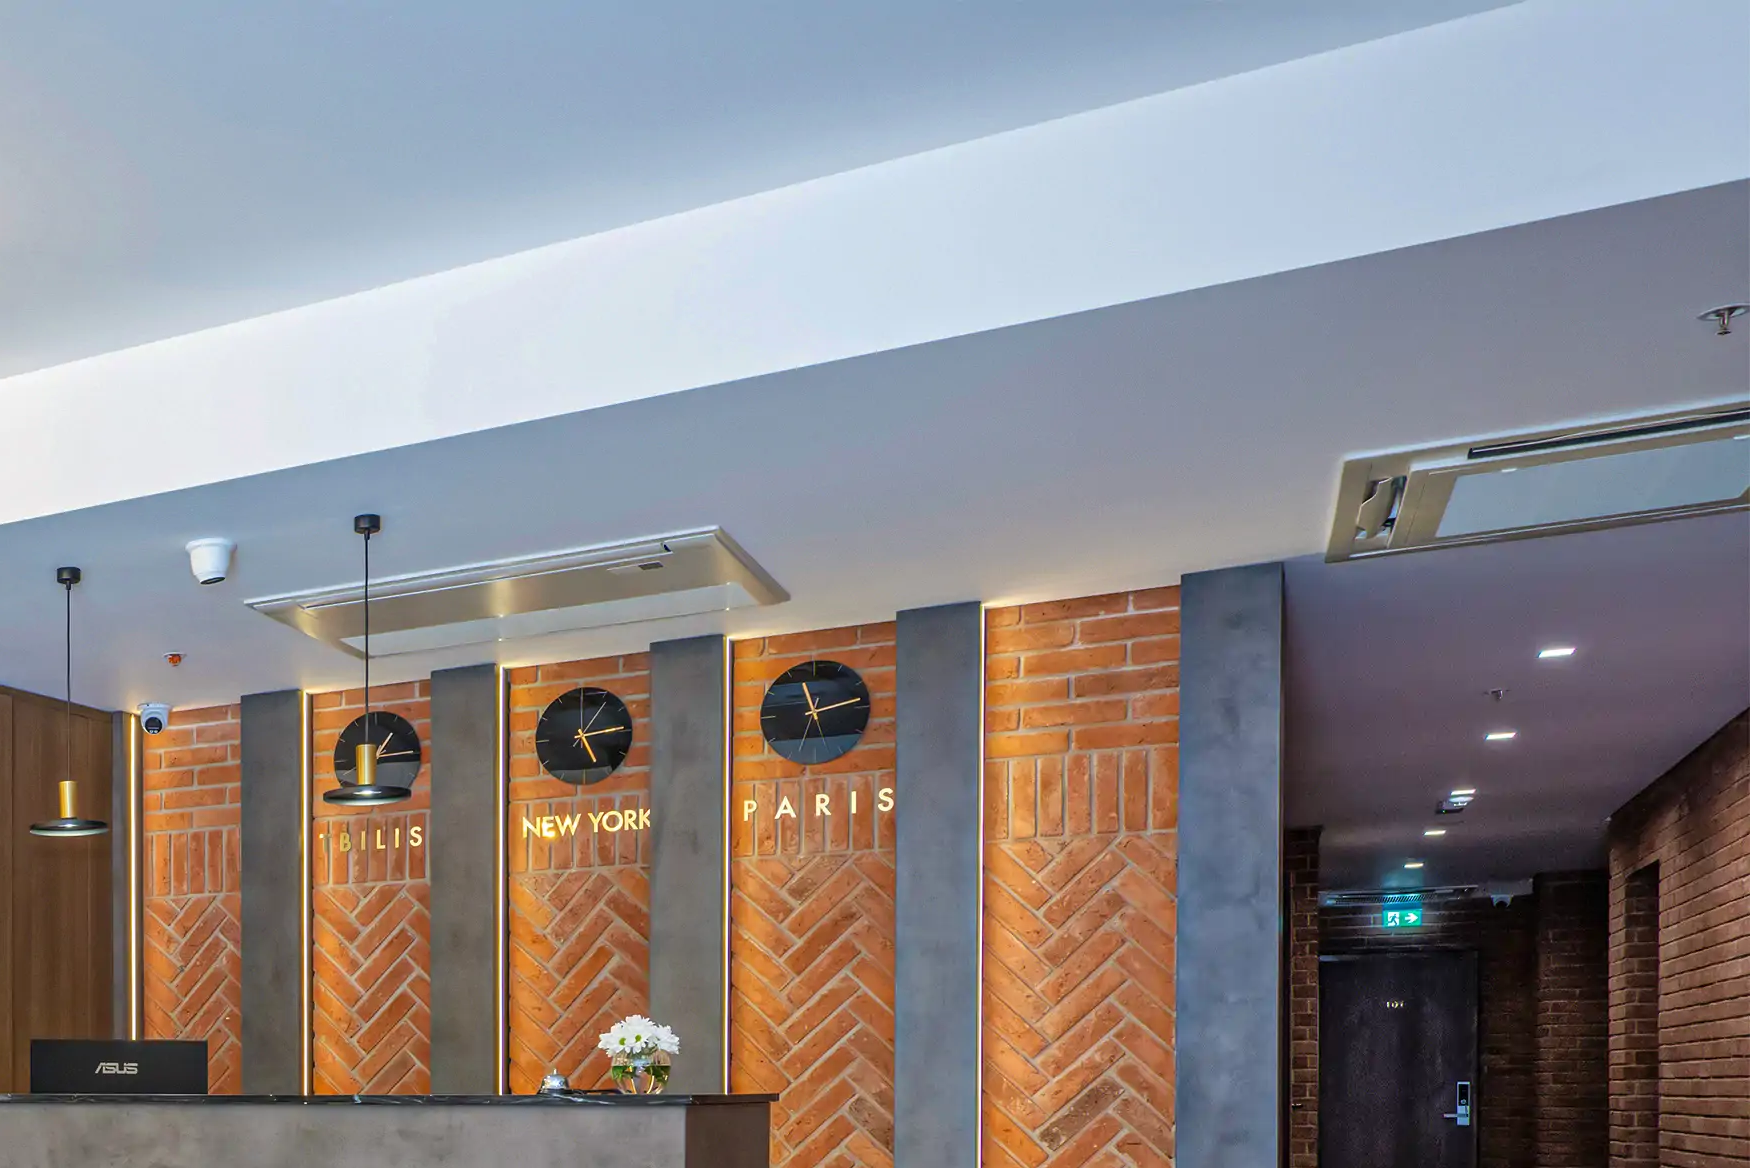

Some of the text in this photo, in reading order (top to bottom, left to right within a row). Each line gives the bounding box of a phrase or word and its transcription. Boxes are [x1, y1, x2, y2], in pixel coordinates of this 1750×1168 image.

[743, 787, 895, 822] PARIS
[522, 808, 651, 838] NEW YORK
[94, 1062, 139, 1075] ASUS
